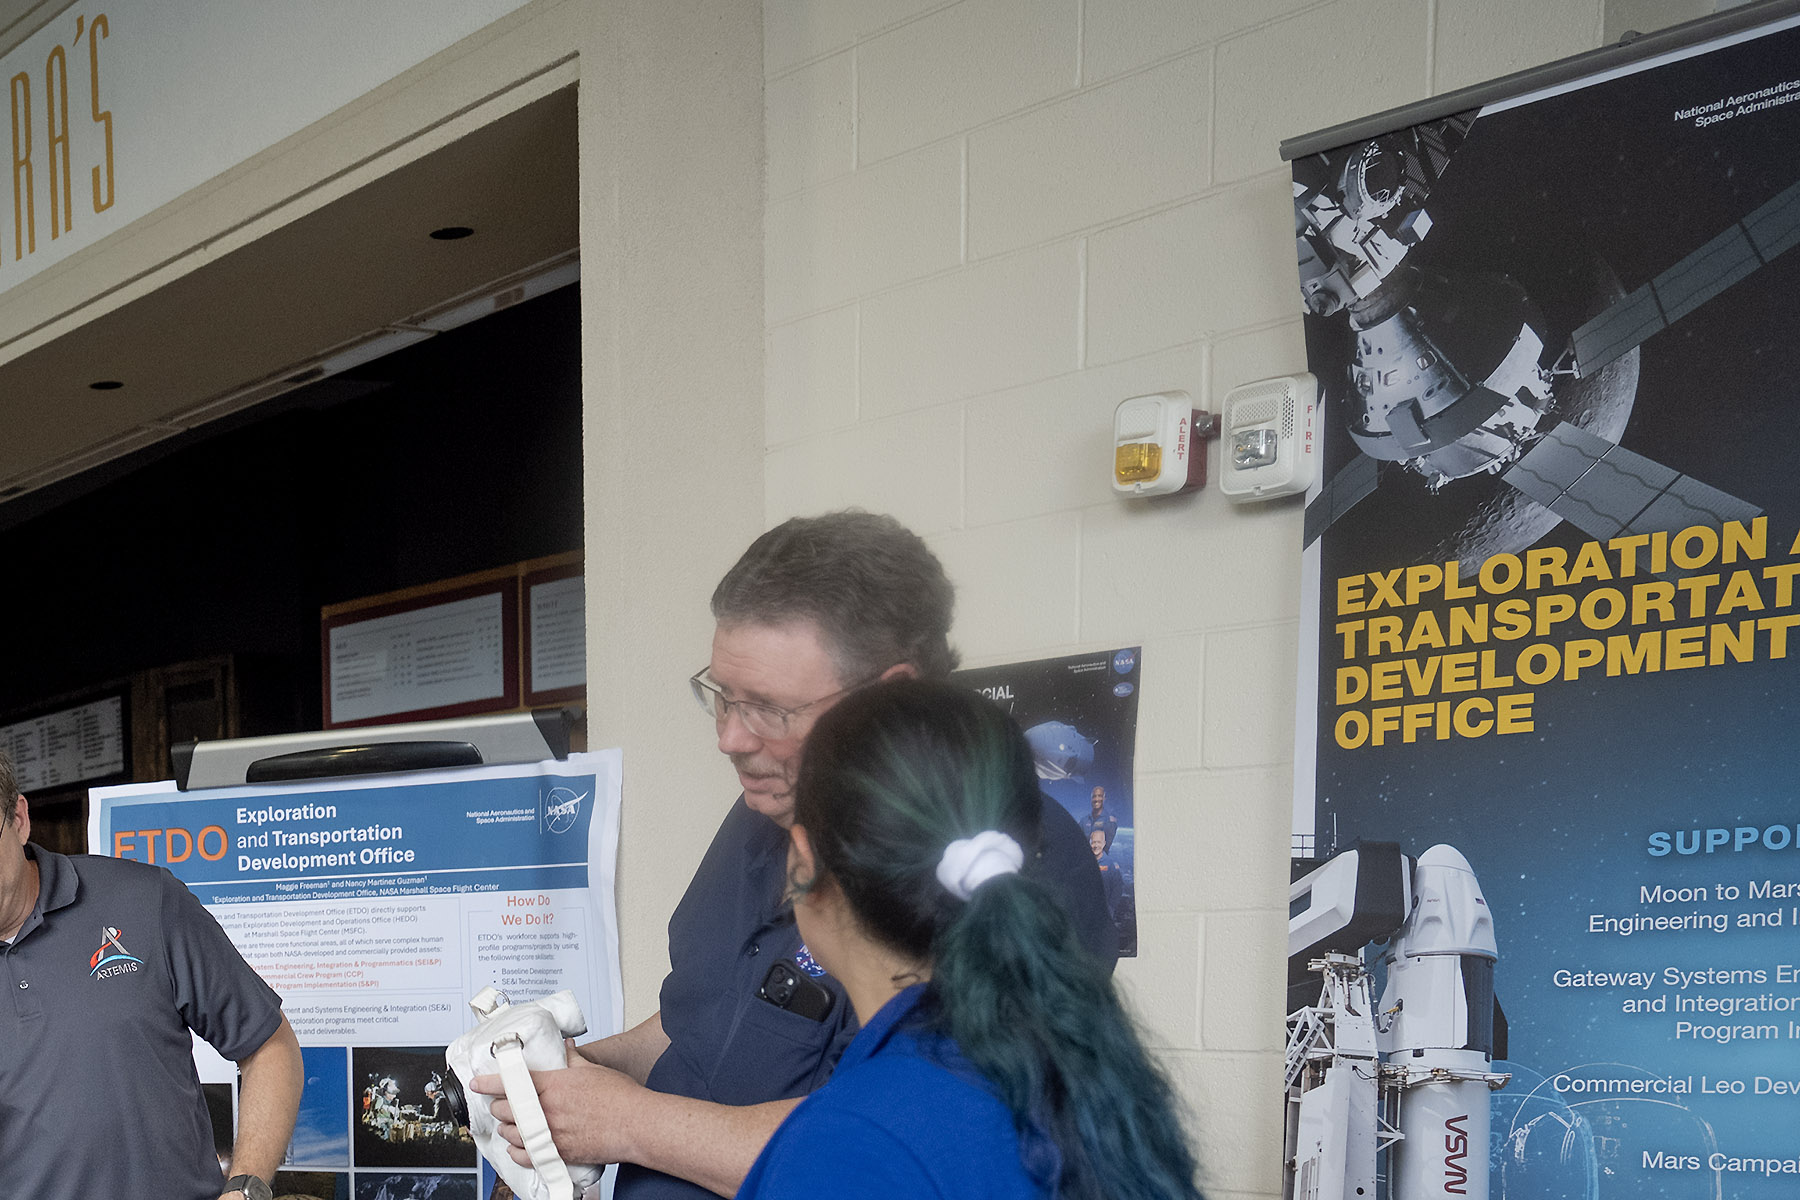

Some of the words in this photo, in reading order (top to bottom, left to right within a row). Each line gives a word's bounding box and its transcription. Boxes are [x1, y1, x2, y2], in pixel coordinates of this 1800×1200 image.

[1674, 99, 1724, 121] National
[1725, 79, 1800, 107] Aeronautics
[1695, 110, 1734, 127] Space
[1735, 91, 1800, 117] Administra
[1177, 417, 1187, 460] ALERT
[1304, 405, 1313, 454] FIRE
[1337, 515, 1768, 616] EXPLORATION
[1335, 563, 1800, 660] TRANSPORTAT
[1335, 613, 1800, 705] DEVELOPMENT
[1334, 692, 1535, 750] OFFICE
[236, 803, 337, 826] Exploration
[476, 817, 494, 825] Space
[495, 815, 535, 823] Administration
[490, 809, 524, 817] Aeronautics
[114, 824, 229, 864] ETDO
[237, 831, 268, 849] and
[271, 824, 403, 849] Transportation
[1647, 823, 1800, 857] SUPPO
[238, 851, 356, 872] Development
[359, 847, 415, 865] Office
[265, 892, 312, 901] Transportation
[312, 889, 355, 900] Development
[379, 887, 399, 896] NASA
[399, 885, 428, 895] Marshall
[429, 884, 451, 894] Space
[452, 883, 473, 893] Flight
[474, 883, 500, 891] Center
[275, 882, 298, 891] Maggie
[331, 880, 345, 888] and
[345, 879, 367, 888] Nancy
[367, 877, 396, 887] Martinez
[1640, 885, 1707, 904] Moon
[1715, 883, 1740, 900] to
[1749, 880, 1800, 899] Mar
[507, 895, 535, 907] How
[537, 894, 550, 906] Do
[501, 914, 522, 926] We
[525, 913, 541, 925] Do
[542, 912, 554, 925] It?
[1589, 911, 1728, 936] Engineering
[1736, 908, 1782, 928] and
[97, 962, 138, 981] ARTEMIS
[1553, 969, 1656, 990] Gateway
[1662, 966, 1767, 990] Systems
[314, 1006, 343, 1014] Systems
[343, 1005, 382, 1014] Engineering
[389, 1004, 428, 1013] Integration
[1622, 994, 1666, 1013] and
[325, 1017, 356, 1025] programs
[1676, 1021, 1779, 1044] Program
[1553, 1074, 1692, 1094] Commercial
[1701, 1075, 1746, 1095] Leo
[1754, 1076, 1800, 1095] Dev
[1443, 1114, 1469, 1195] NASA
[1642, 1150, 1701, 1171] Mars
